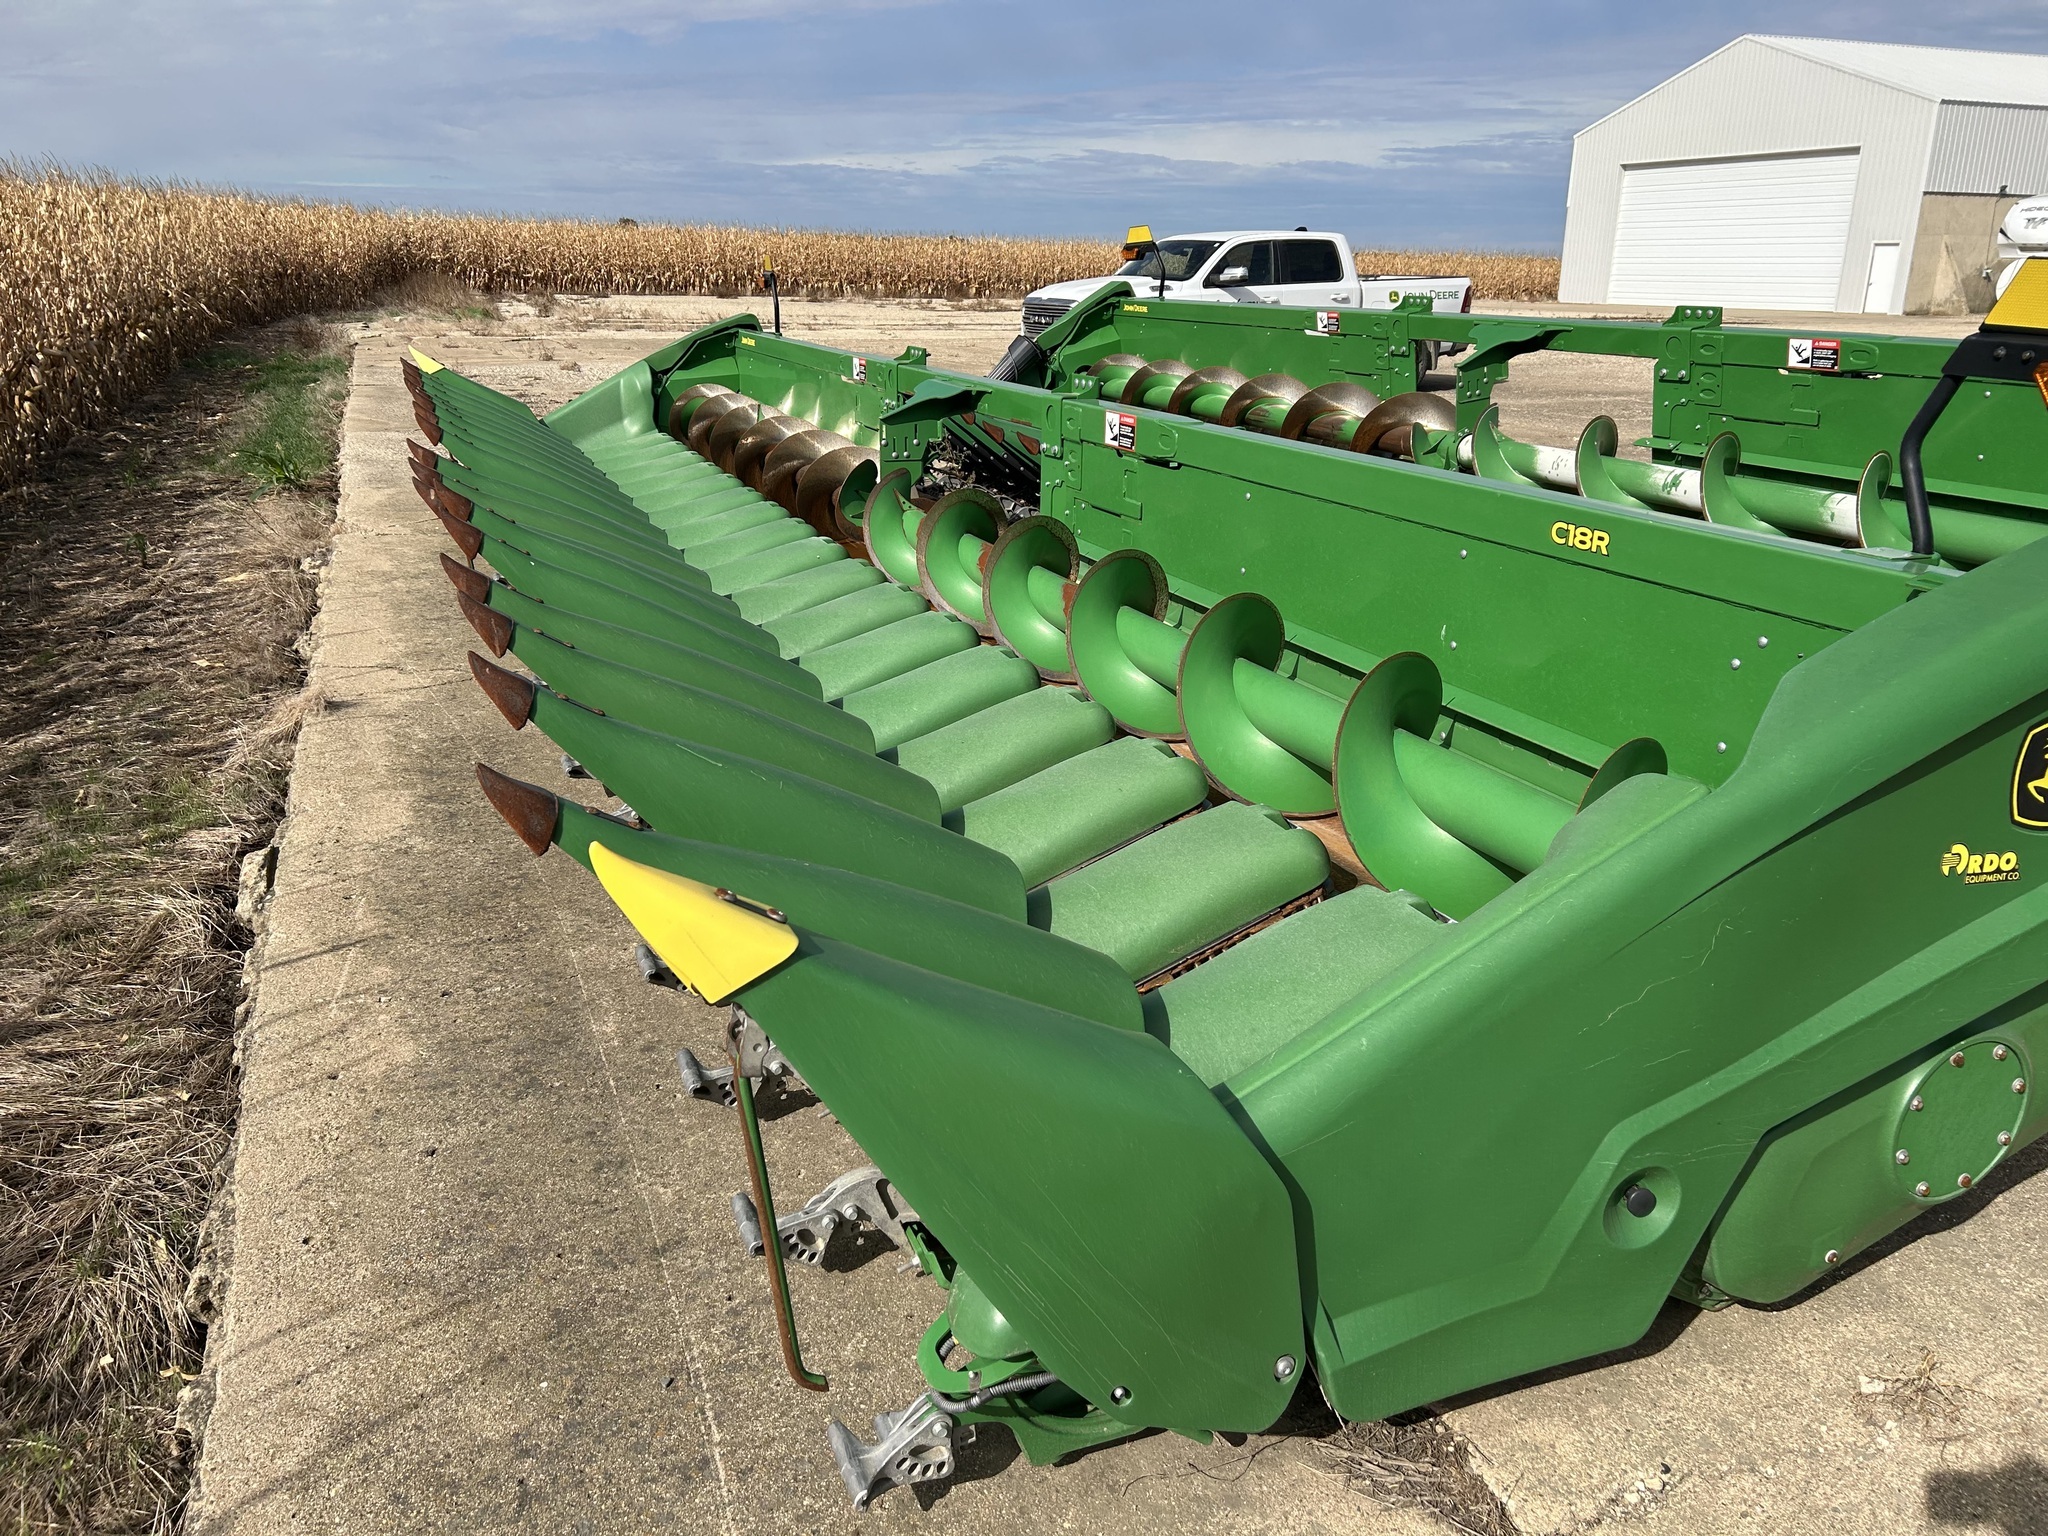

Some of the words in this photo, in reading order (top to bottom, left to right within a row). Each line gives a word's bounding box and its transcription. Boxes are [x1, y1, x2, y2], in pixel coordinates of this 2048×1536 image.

[1429, 290, 1460, 299] DEERE
[1551, 520, 1610, 556] C18R
[1965, 873, 2007, 884] EQUIPMENT
